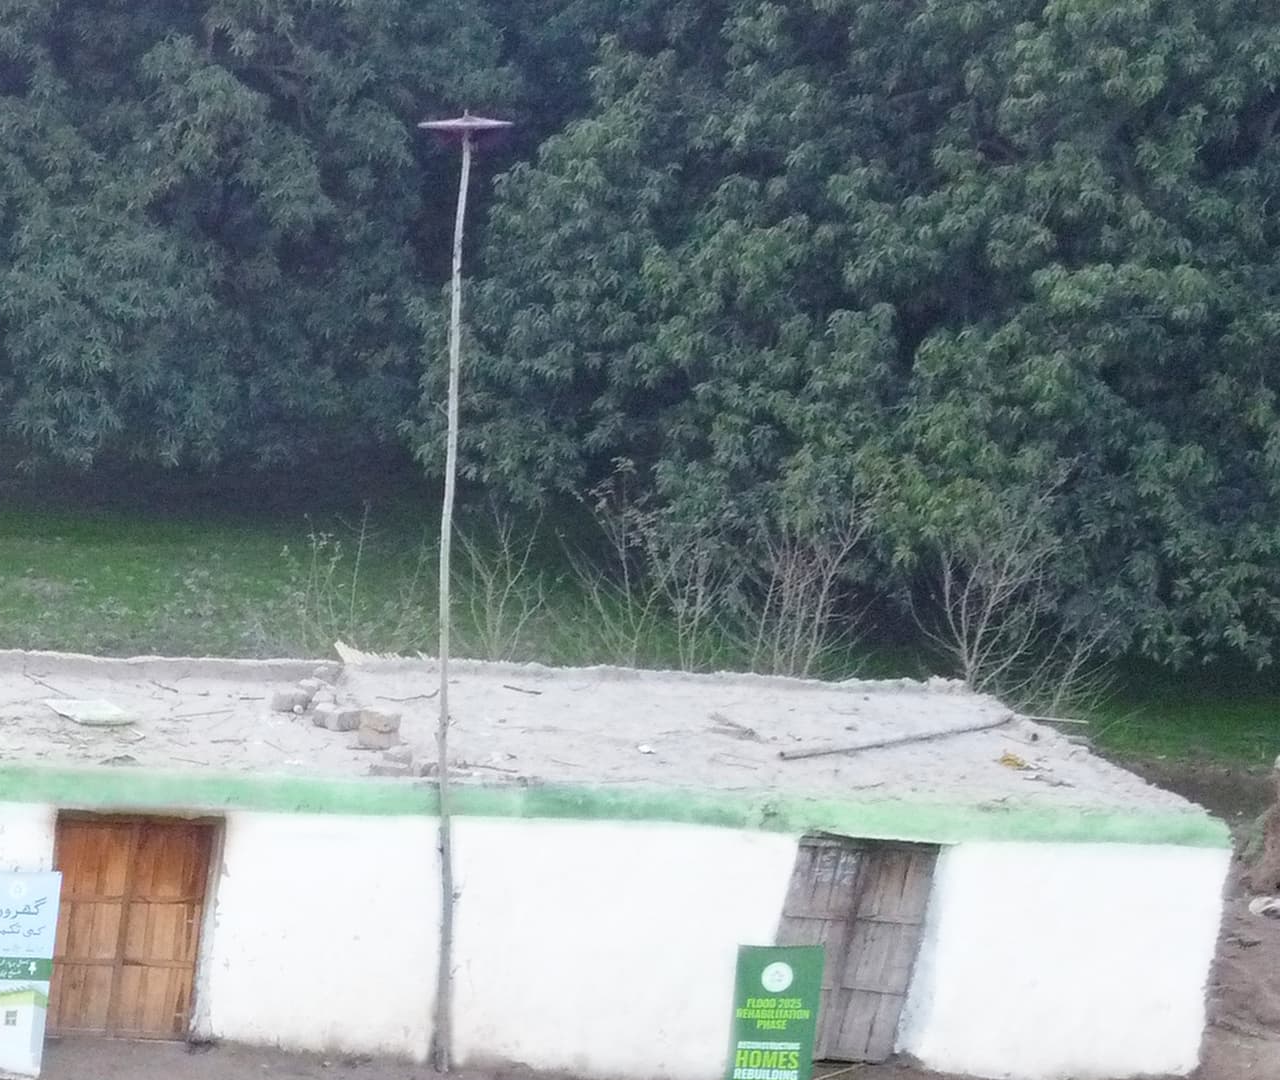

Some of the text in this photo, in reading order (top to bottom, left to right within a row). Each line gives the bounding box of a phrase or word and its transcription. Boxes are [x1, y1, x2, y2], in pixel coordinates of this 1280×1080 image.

[747, 998, 777, 1009] FLOOD
[756, 1019, 788, 1031] PHASE
[735, 1050, 800, 1069] HOMES
[733, 1068, 800, 1080] REBUILDING
